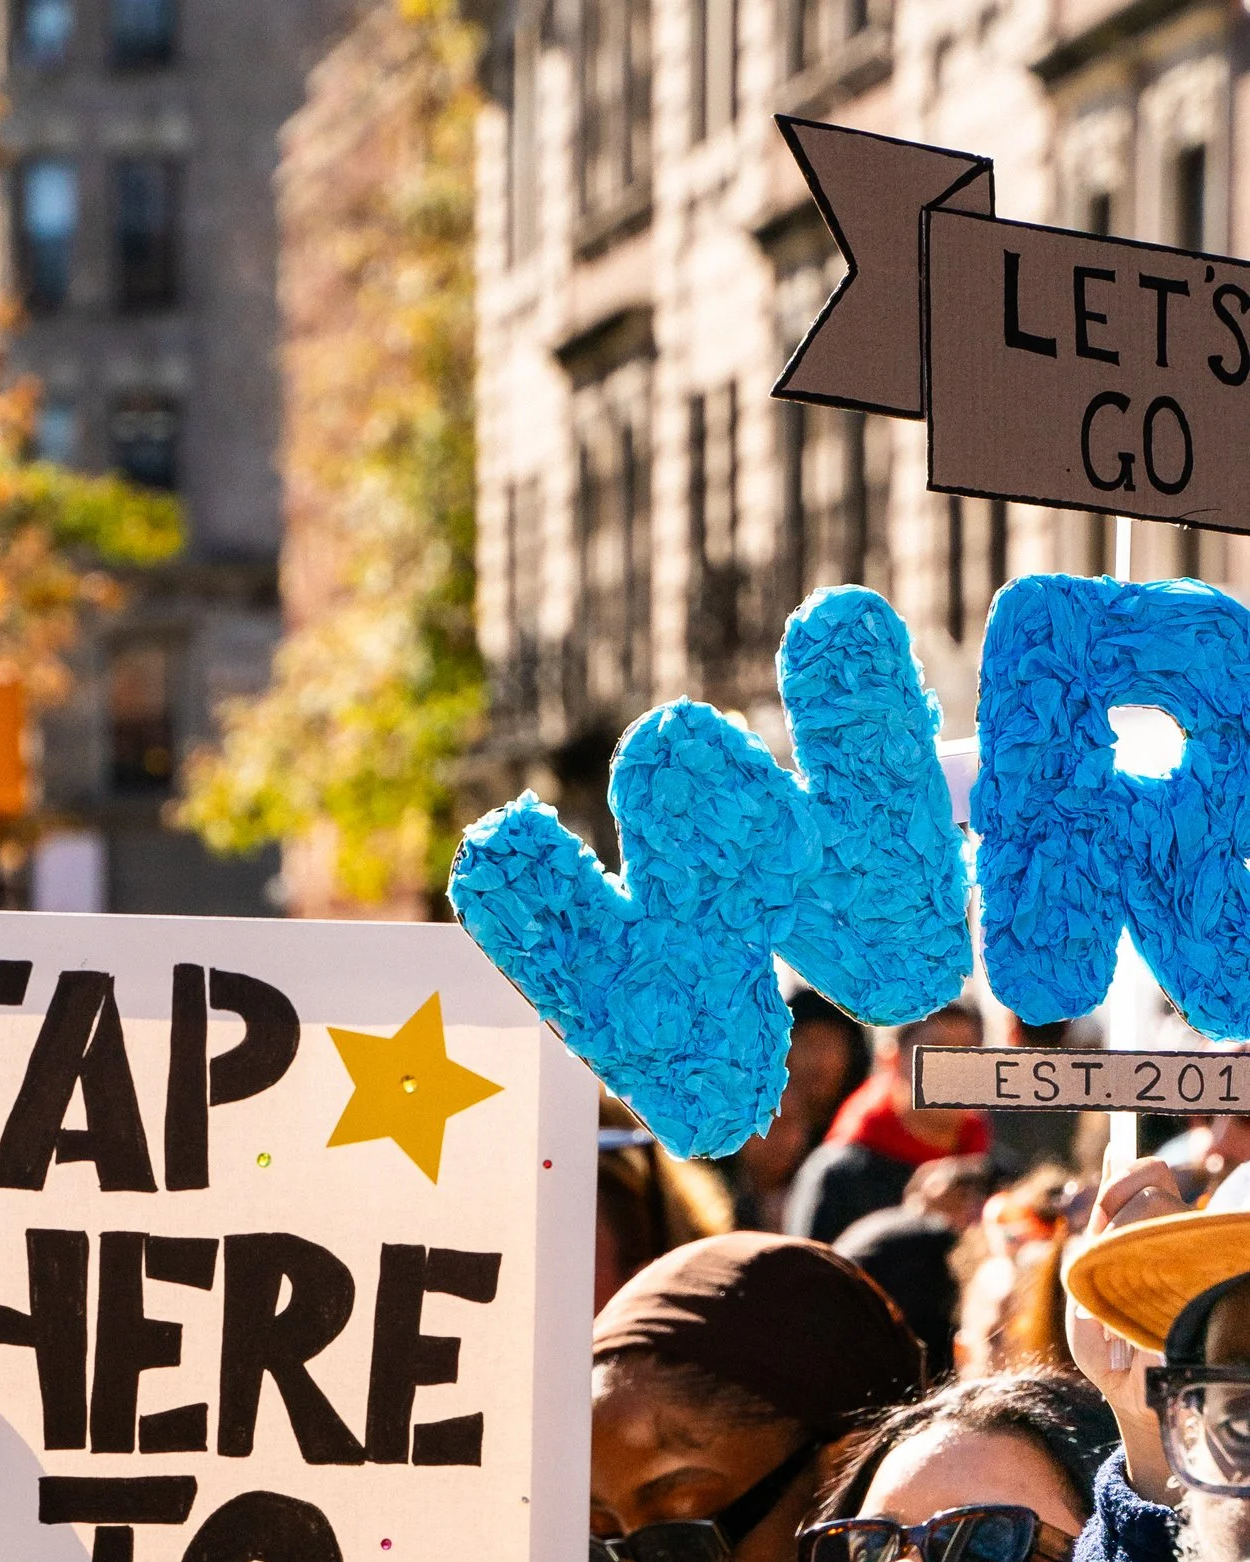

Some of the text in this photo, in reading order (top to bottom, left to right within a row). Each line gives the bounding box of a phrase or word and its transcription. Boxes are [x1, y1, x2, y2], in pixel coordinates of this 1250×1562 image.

[1004, 249, 1250, 386] LET'S
[1081, 391, 1193, 495] GO
[996, 1061, 1240, 1102] EST. 201
